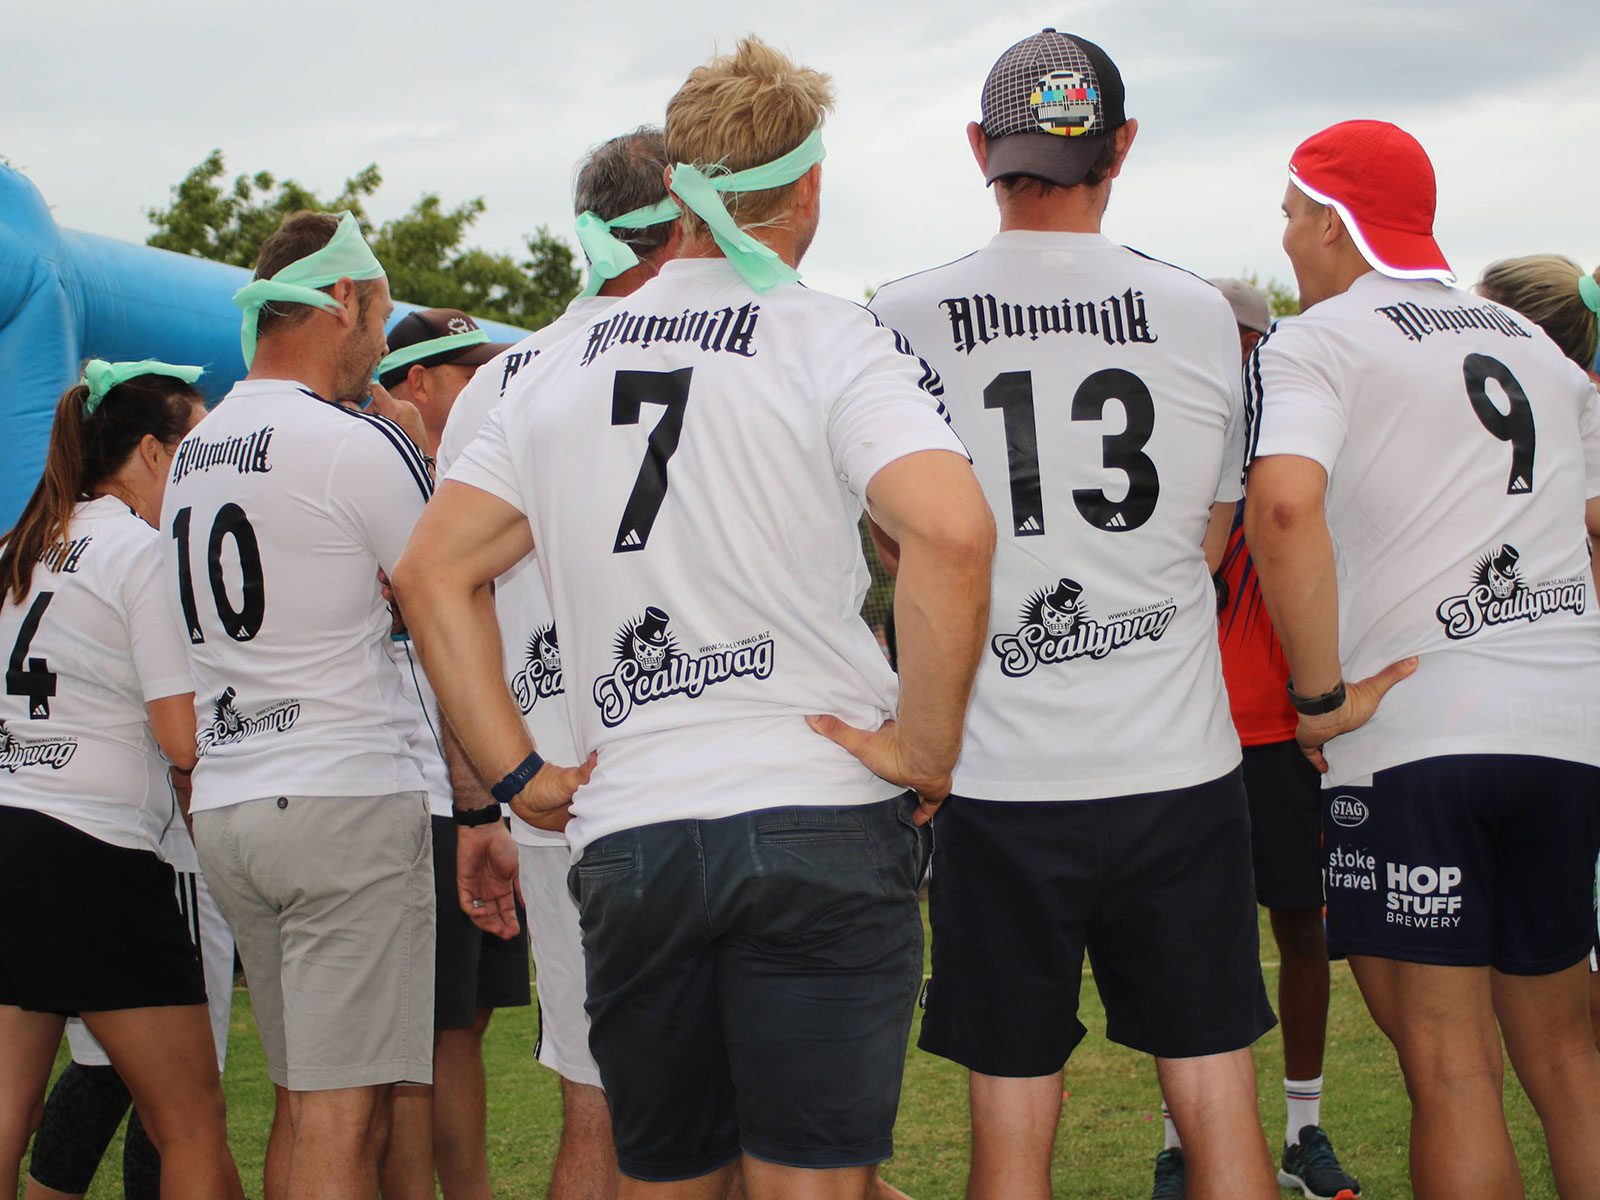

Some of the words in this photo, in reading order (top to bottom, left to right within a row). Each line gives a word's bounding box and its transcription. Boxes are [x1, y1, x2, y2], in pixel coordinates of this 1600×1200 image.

[982, 367, 1161, 538] 13
[1462, 352, 1536, 495] 9
[611, 366, 695, 554] 7
[171, 502, 266, 645] 10
[990, 604, 1177, 678] Scallywag
[1435, 582, 1586, 641] Scallywag
[5, 591, 58, 720] 4
[592, 640, 775, 728] Scallywag
[0, 742, 78, 774] allywag
[1333, 800, 1363, 816] STAG
[1328, 844, 1377, 870] stoke
[1328, 867, 1377, 891] travel
[1386, 862, 1462, 894] HOP
[1386, 891, 1462, 915] STUFF
[1386, 911, 1461, 928] BREWERY
